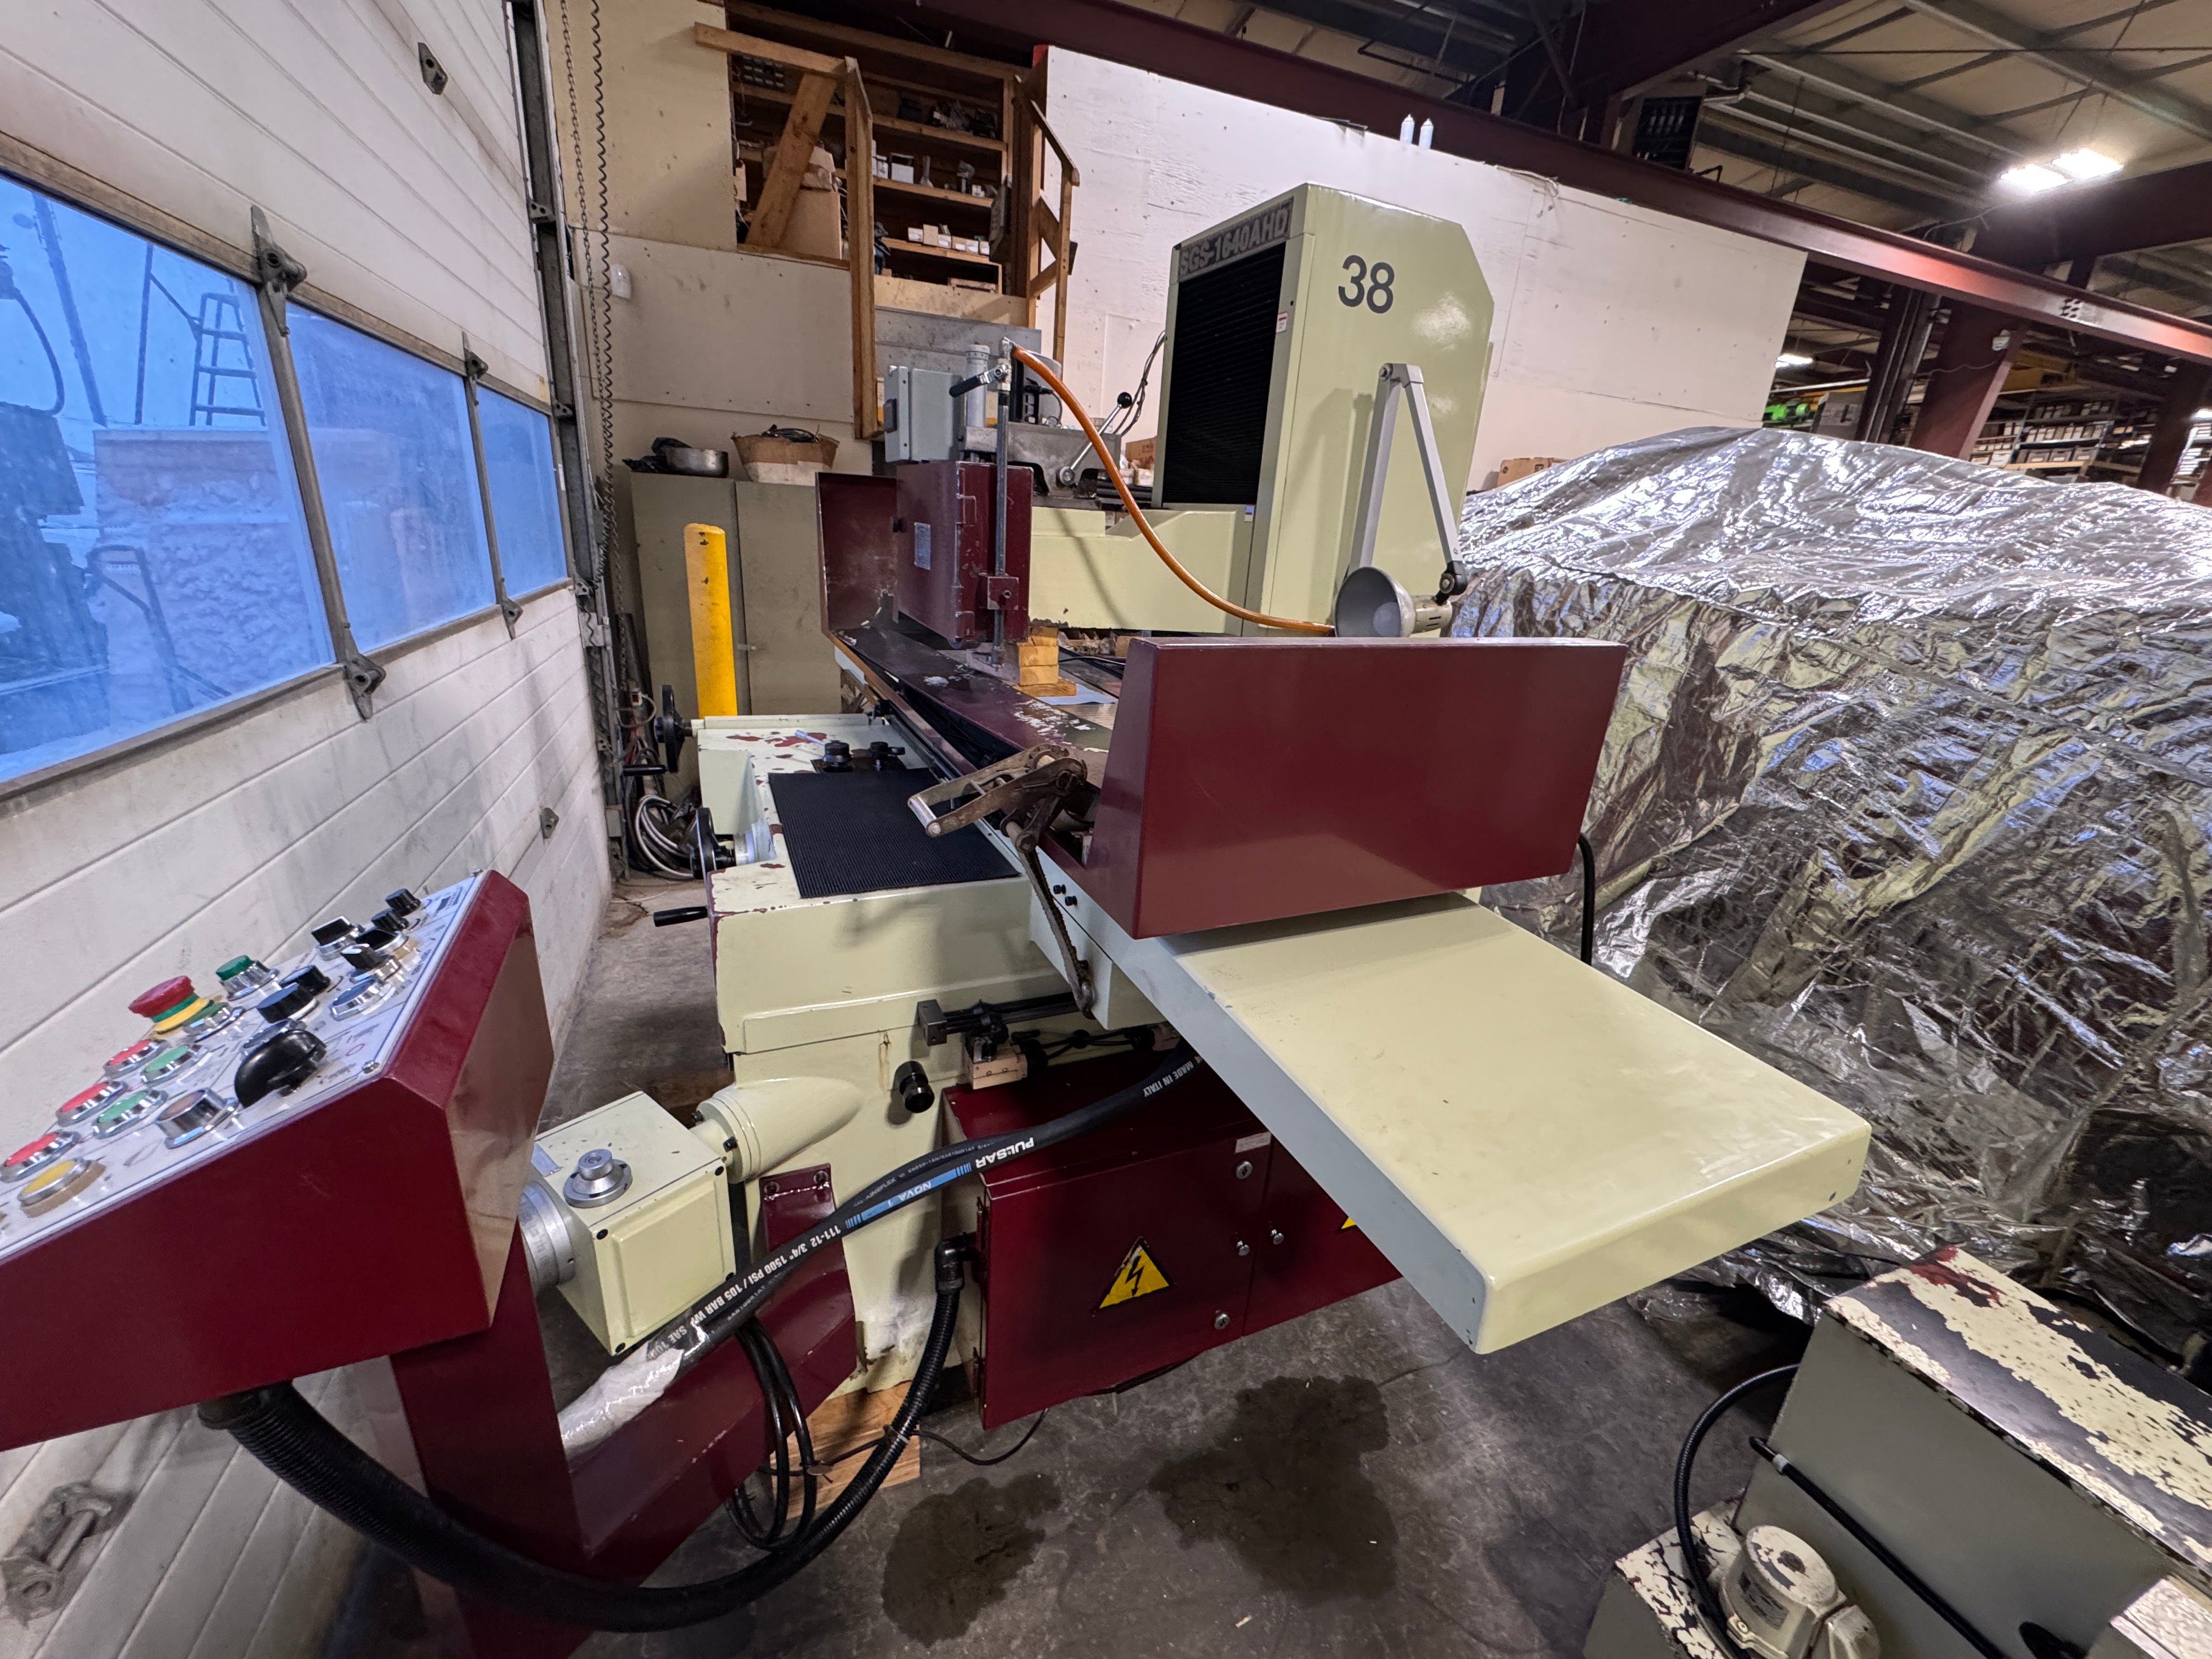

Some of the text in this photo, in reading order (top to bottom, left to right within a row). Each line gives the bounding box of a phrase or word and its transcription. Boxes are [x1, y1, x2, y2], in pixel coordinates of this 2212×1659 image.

[1180, 208, 1288, 274] SGS-1640AHD
[1339, 255, 1395, 314] 38
[1143, 1060, 1194, 1097] MADE IN ITALY
[975, 1137, 1034, 1169] PULSAR
[888, 1181, 932, 1207] NOVA 1
[810, 1225, 841, 1248] 111-12
[789, 1243, 808, 1260] 3/4"
[764, 1255, 787, 1274] 1500
[748, 1269, 765, 1284] PSI
[724, 1284, 743, 1301] 105
[704, 1296, 725, 1314] BAR
[667, 1325, 688, 1342] SAE
